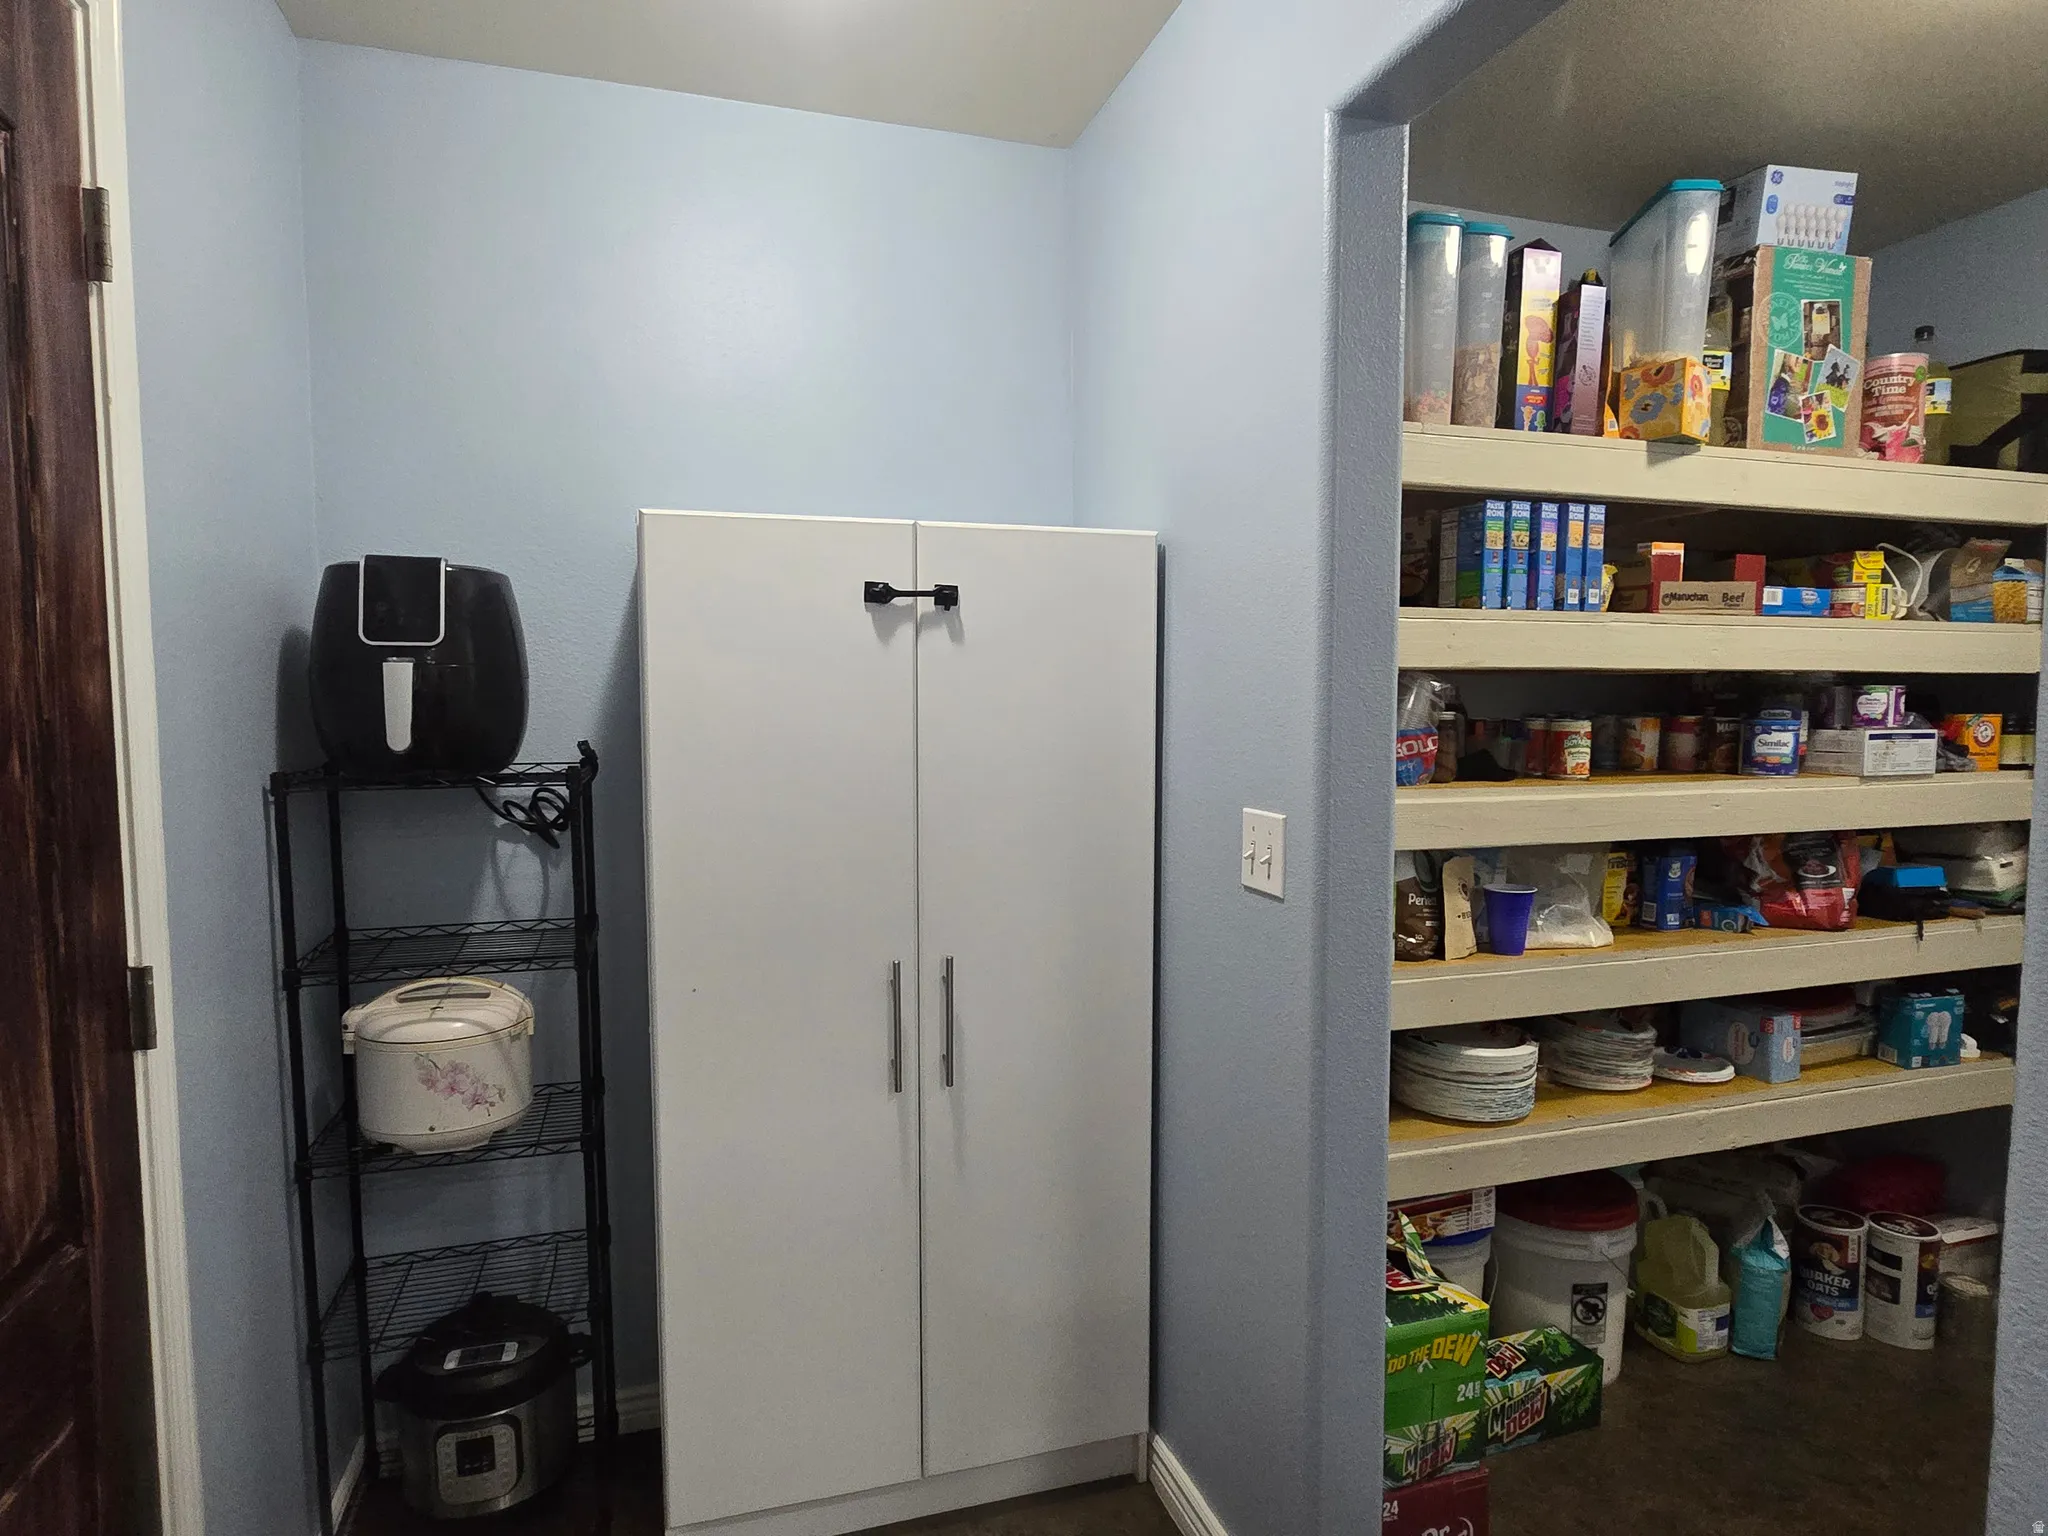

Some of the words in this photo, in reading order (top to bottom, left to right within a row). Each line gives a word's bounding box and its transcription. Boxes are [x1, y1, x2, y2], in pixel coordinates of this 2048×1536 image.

[1863, 374, 1916, 390] Country
[1871, 385, 1908, 397] Time
[1669, 592, 1709, 602] Maruchan
[1722, 592, 1745, 602] Beef
[1757, 738, 1790, 748] Similac
[1800, 1266, 1851, 1290] QUAKER
[1807, 1280, 1839, 1297] OATS
[1408, 1344, 1431, 1366] THE
[1431, 1333, 1480, 1367] DEW
[1457, 1381, 1474, 1402] 24
[1383, 1500, 1399, 1518] 24
